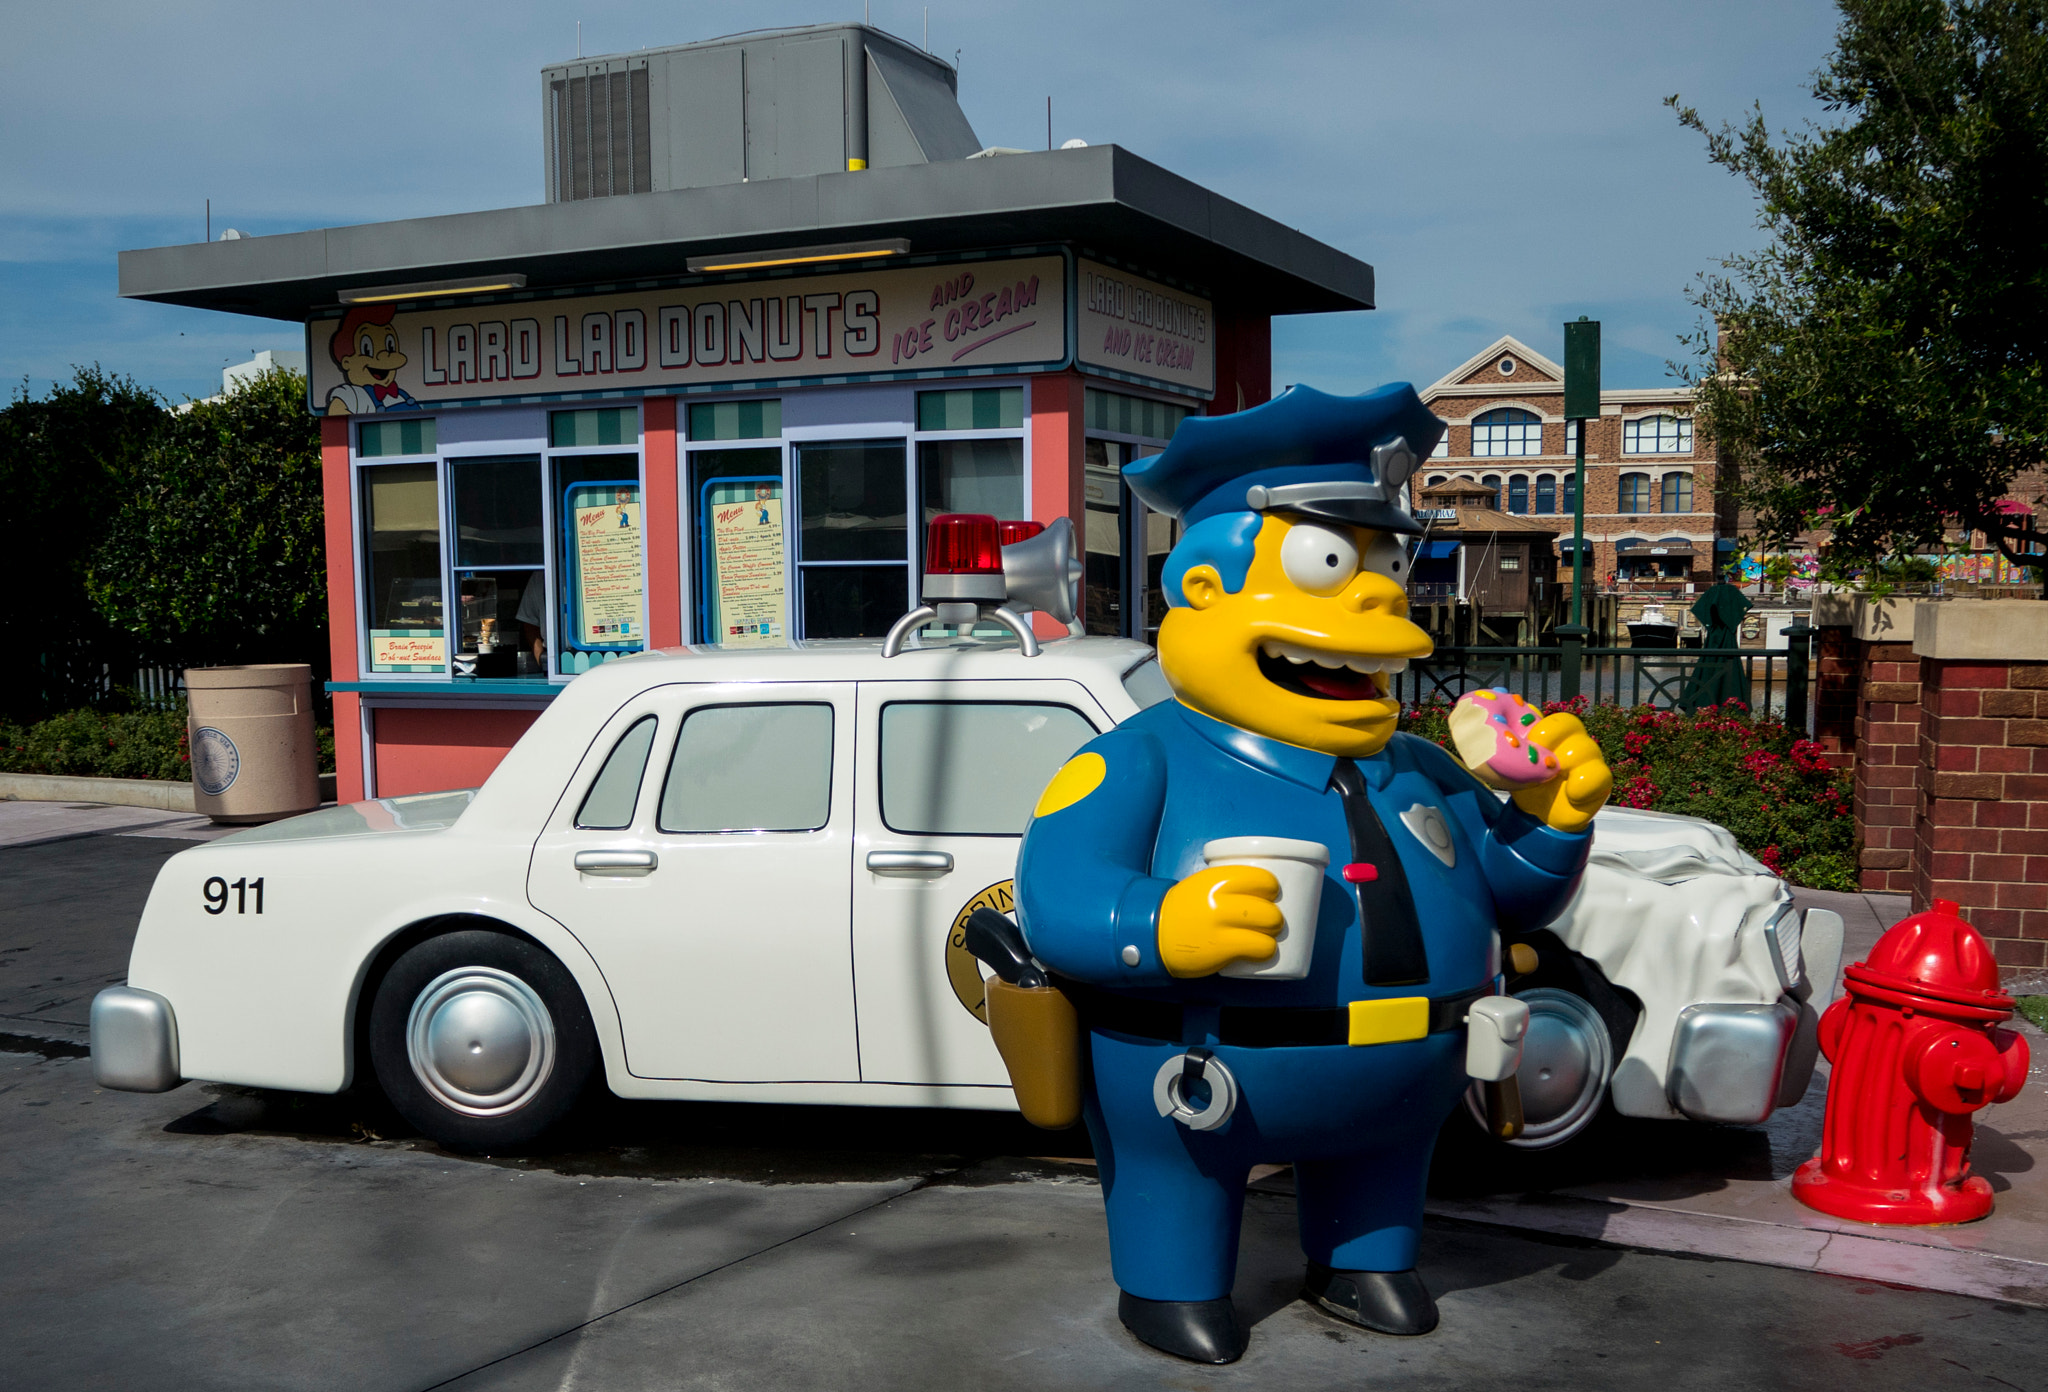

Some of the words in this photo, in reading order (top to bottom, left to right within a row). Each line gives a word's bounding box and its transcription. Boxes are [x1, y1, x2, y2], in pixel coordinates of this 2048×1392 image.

[929, 271, 975, 312] AND
[1087, 271, 1126, 320] LARD
[1127, 284, 1154, 328] LAD
[1155, 293, 1207, 344] DONUTS
[422, 317, 542, 386] LARD
[555, 308, 648, 376] LAD
[658, 289, 881, 371] DONUTS
[891, 318, 936, 365] ICE
[943, 274, 1040, 343] CREAM
[1103, 325, 1133, 357] AND
[1133, 332, 1152, 363] ICE
[1155, 341, 1196, 372] CREAM
[580, 509, 605, 526] Menu
[717, 506, 744, 523] Menu
[388, 641, 409, 651] Brain
[409, 641, 435, 652] Freezin'
[412, 652, 442, 662] Sundaes
[203, 876, 264, 915] 911
